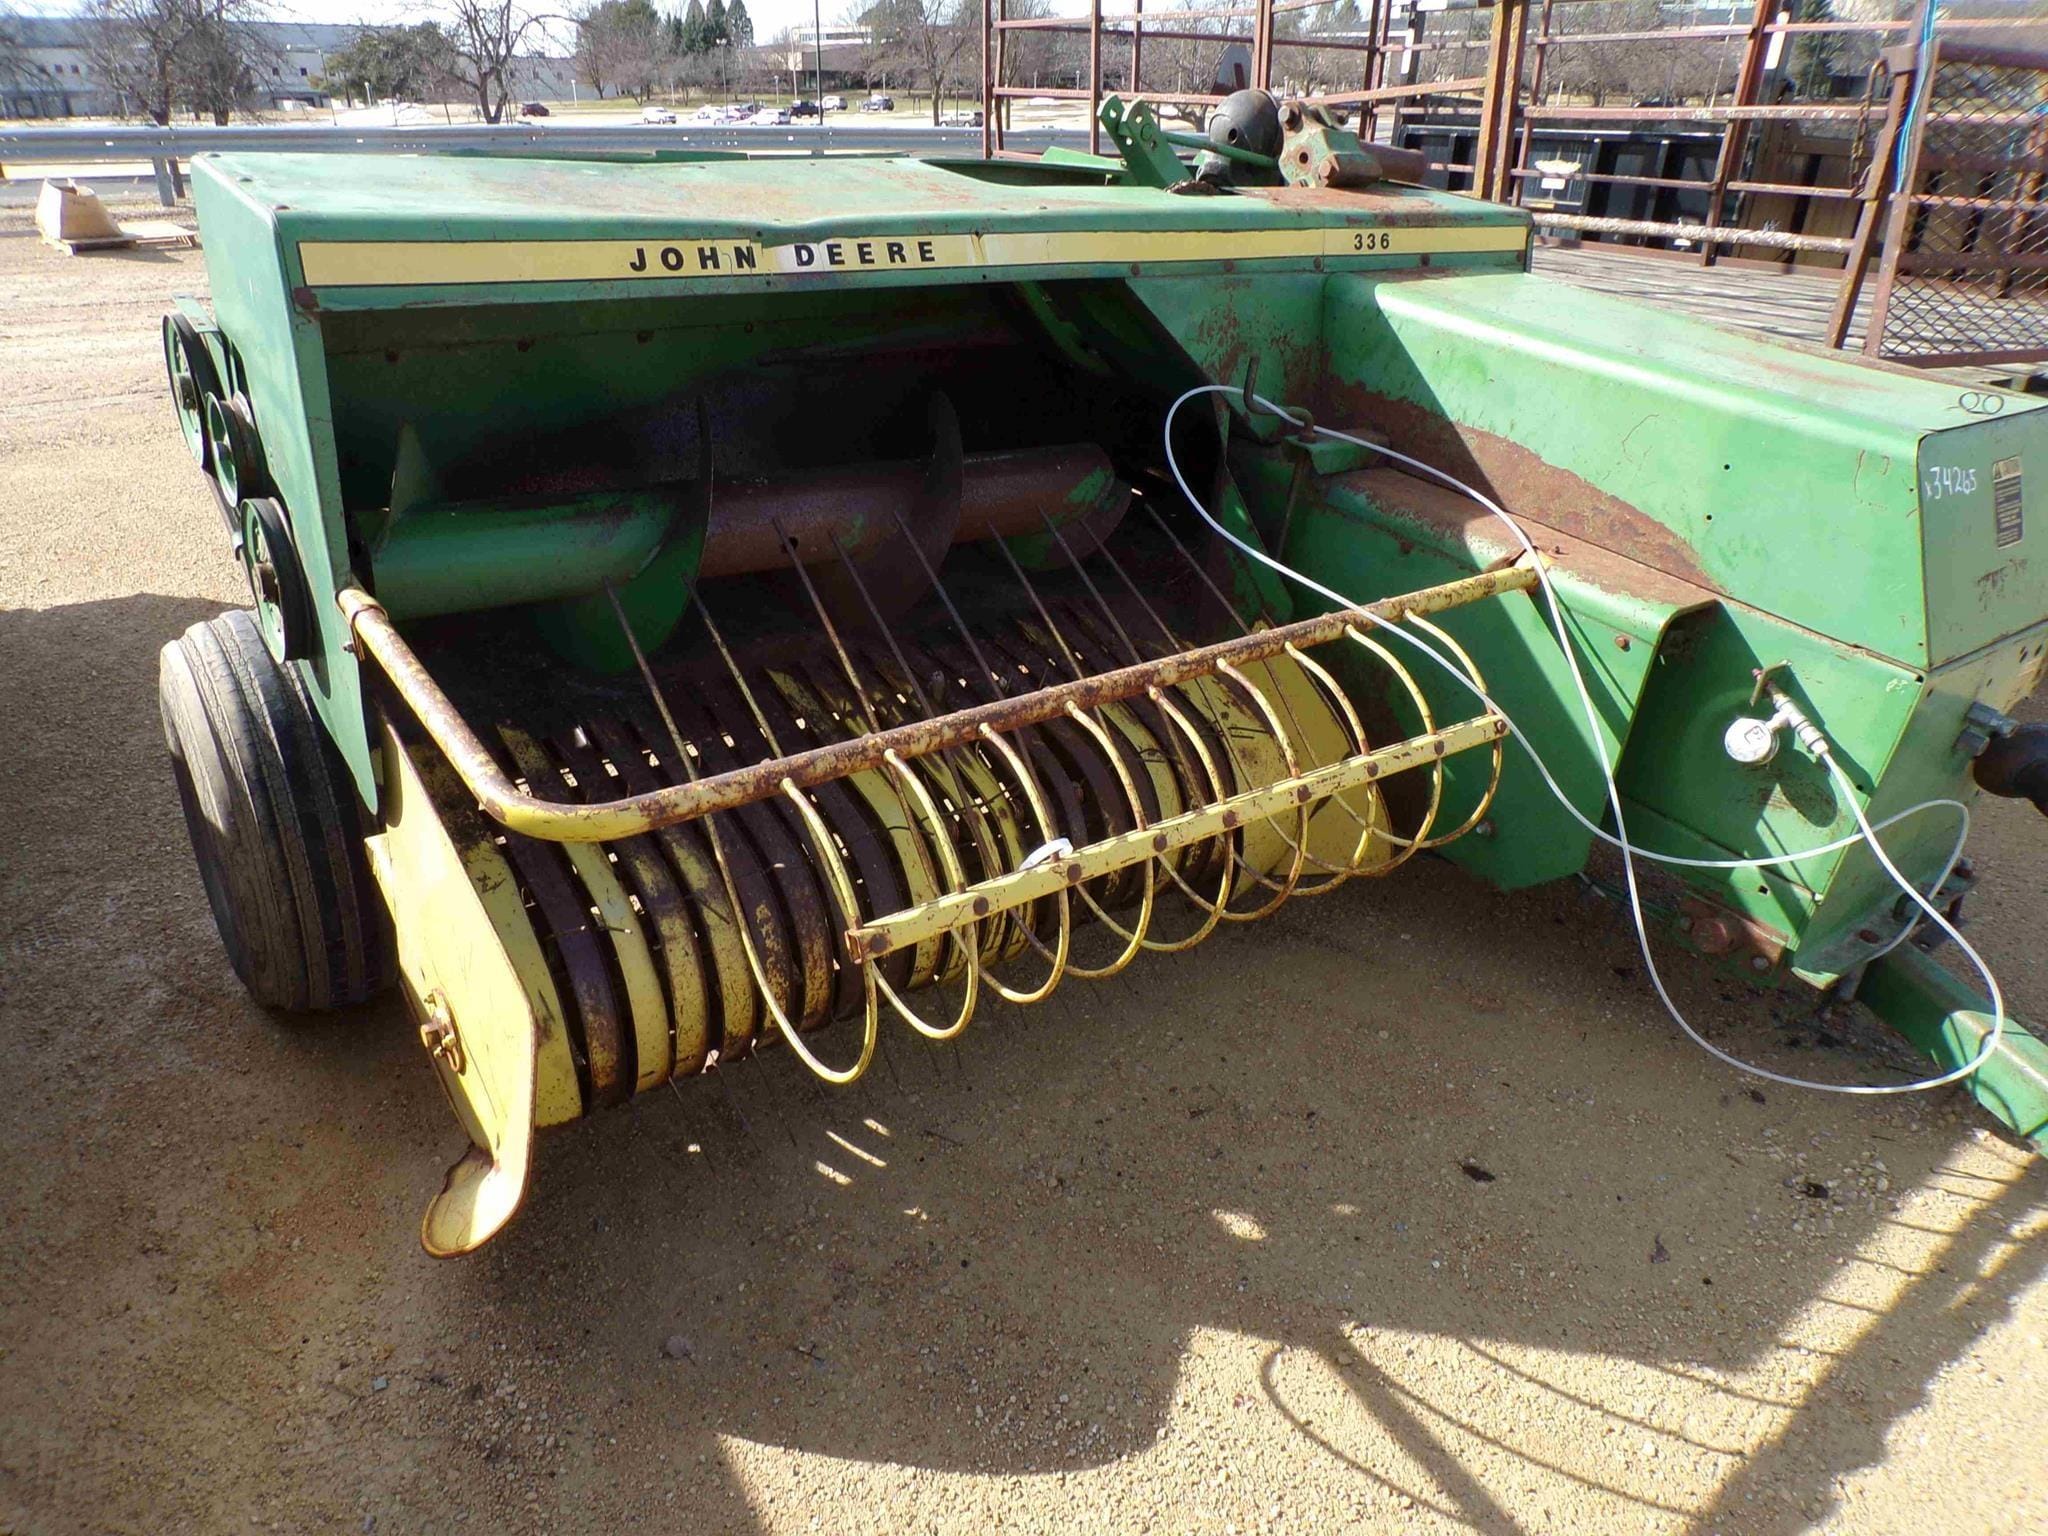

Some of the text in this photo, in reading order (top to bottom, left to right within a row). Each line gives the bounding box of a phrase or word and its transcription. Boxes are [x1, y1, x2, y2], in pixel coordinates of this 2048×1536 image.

[1354, 232, 1390, 251] 336
[629, 240, 936, 273] JOHN DEERE
